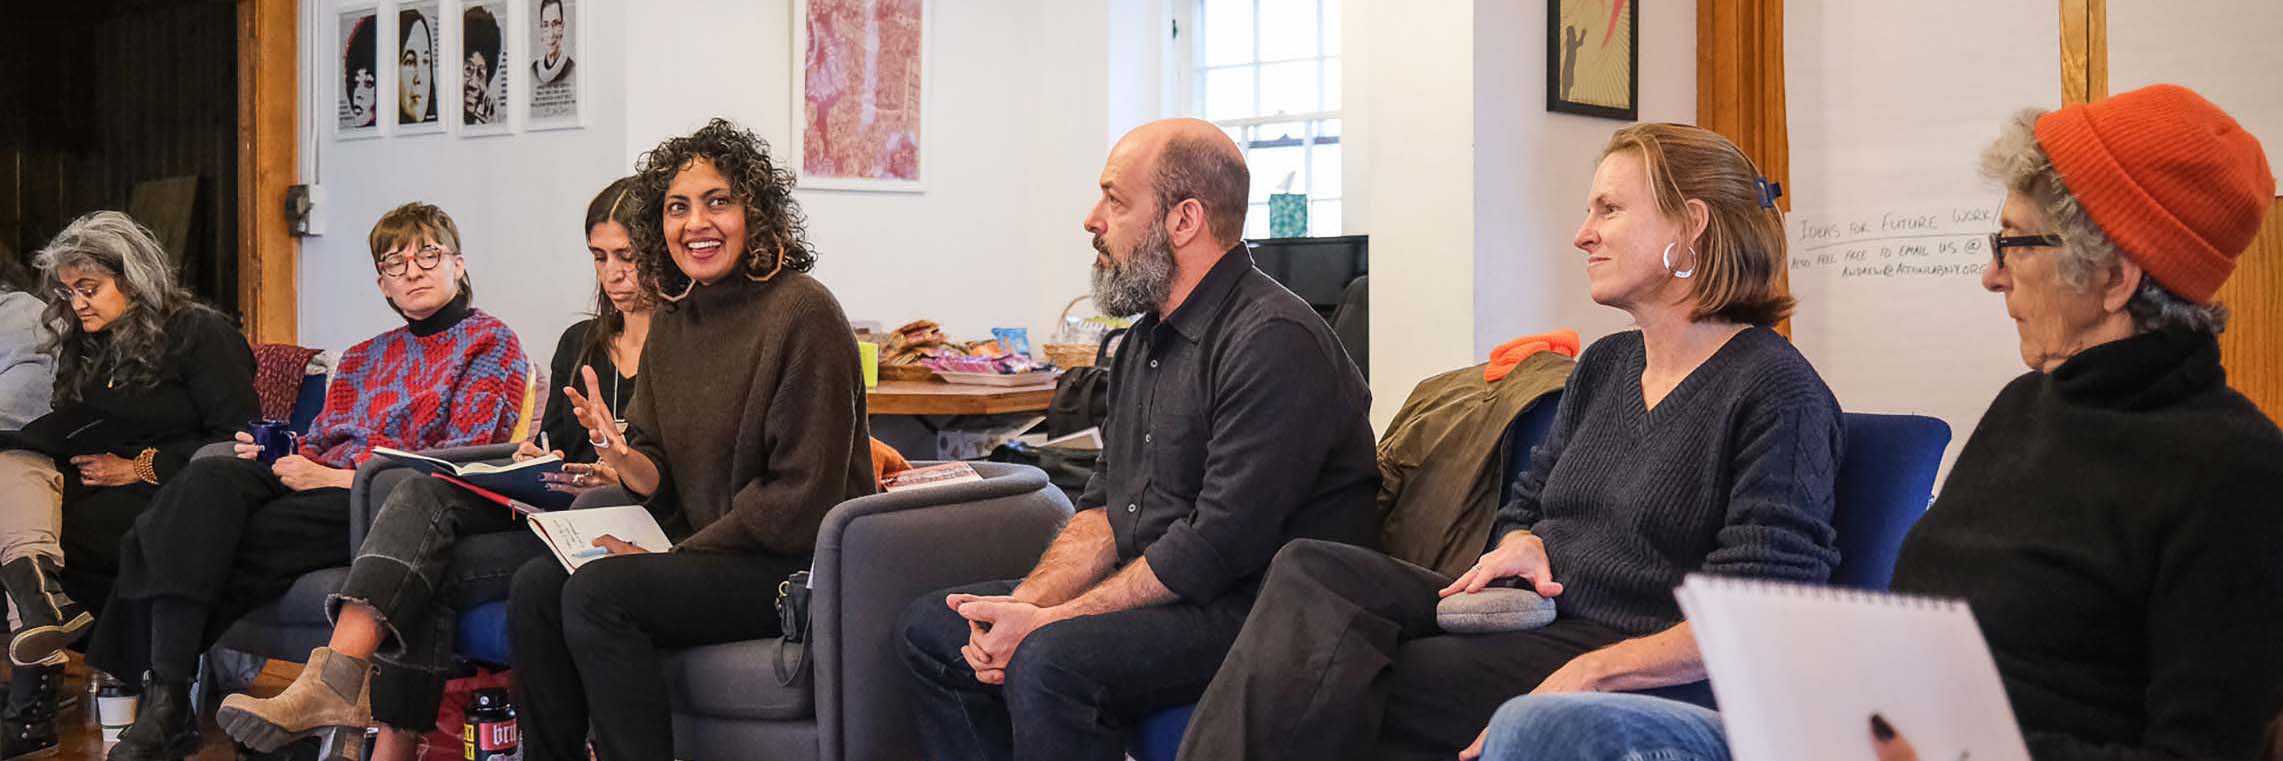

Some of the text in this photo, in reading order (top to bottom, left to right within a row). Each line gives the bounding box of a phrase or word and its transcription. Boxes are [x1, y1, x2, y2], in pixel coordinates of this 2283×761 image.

[1800, 219, 1840, 241] IDEAS
[1849, 221, 1870, 235] FOR
[1881, 212, 1938, 231] FUTURE
[1844, 249, 1867, 261] FREE
[1881, 247, 1892, 258] TO
[1899, 244, 1929, 257] EMAIL
[1939, 241, 1958, 254] US
[1964, 238, 1981, 255] @
